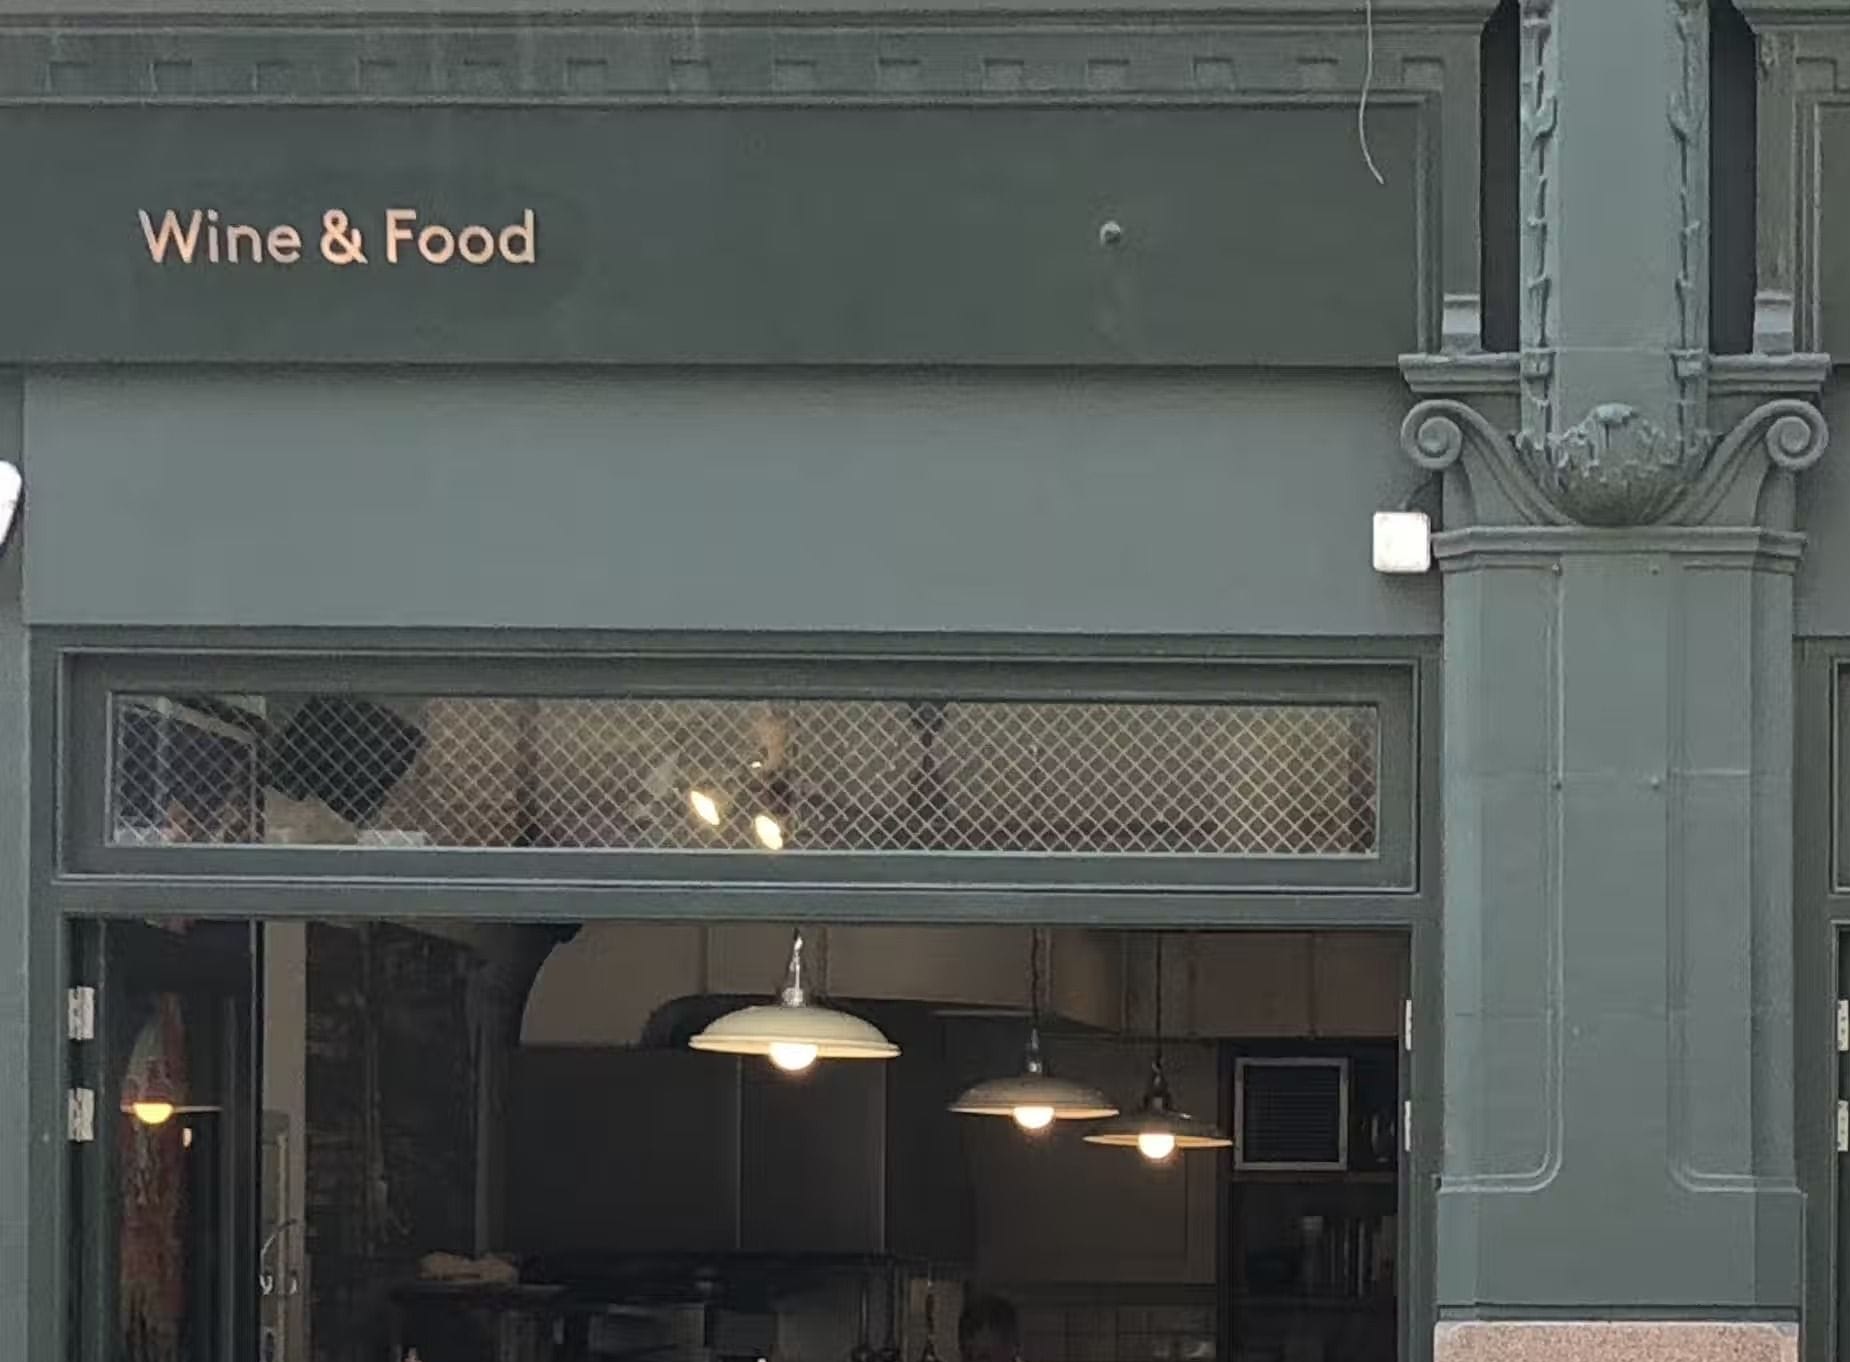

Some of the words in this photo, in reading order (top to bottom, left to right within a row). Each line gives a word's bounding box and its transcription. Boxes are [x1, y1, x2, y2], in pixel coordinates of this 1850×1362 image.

[137, 208, 302, 265] Wine
[319, 208, 369, 265] &
[384, 208, 537, 265] Food
